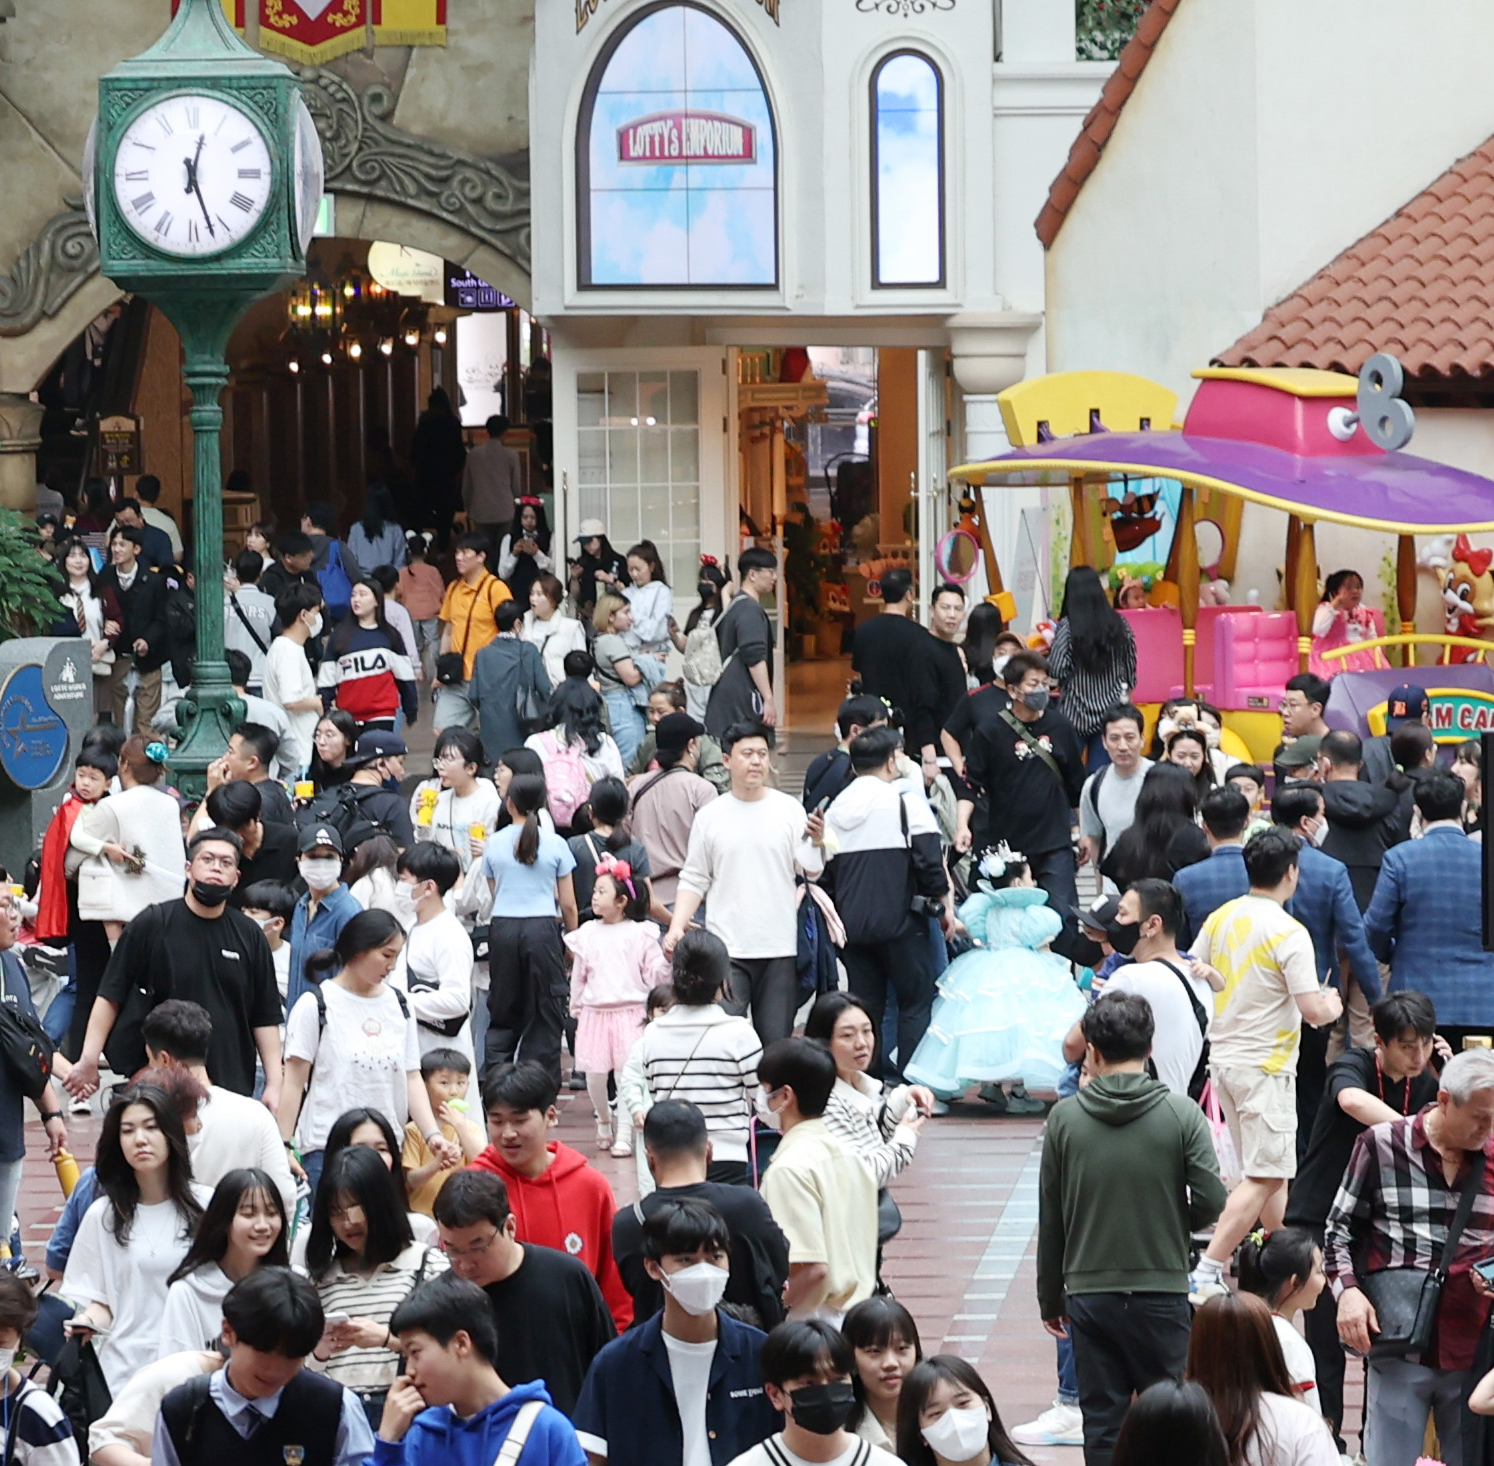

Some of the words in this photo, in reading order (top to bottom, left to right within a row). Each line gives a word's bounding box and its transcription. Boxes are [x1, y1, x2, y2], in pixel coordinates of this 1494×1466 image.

[681, 118, 744, 157] EMPORIUM
[450, 277, 478, 288] South
[342, 653, 387, 677] FILA
